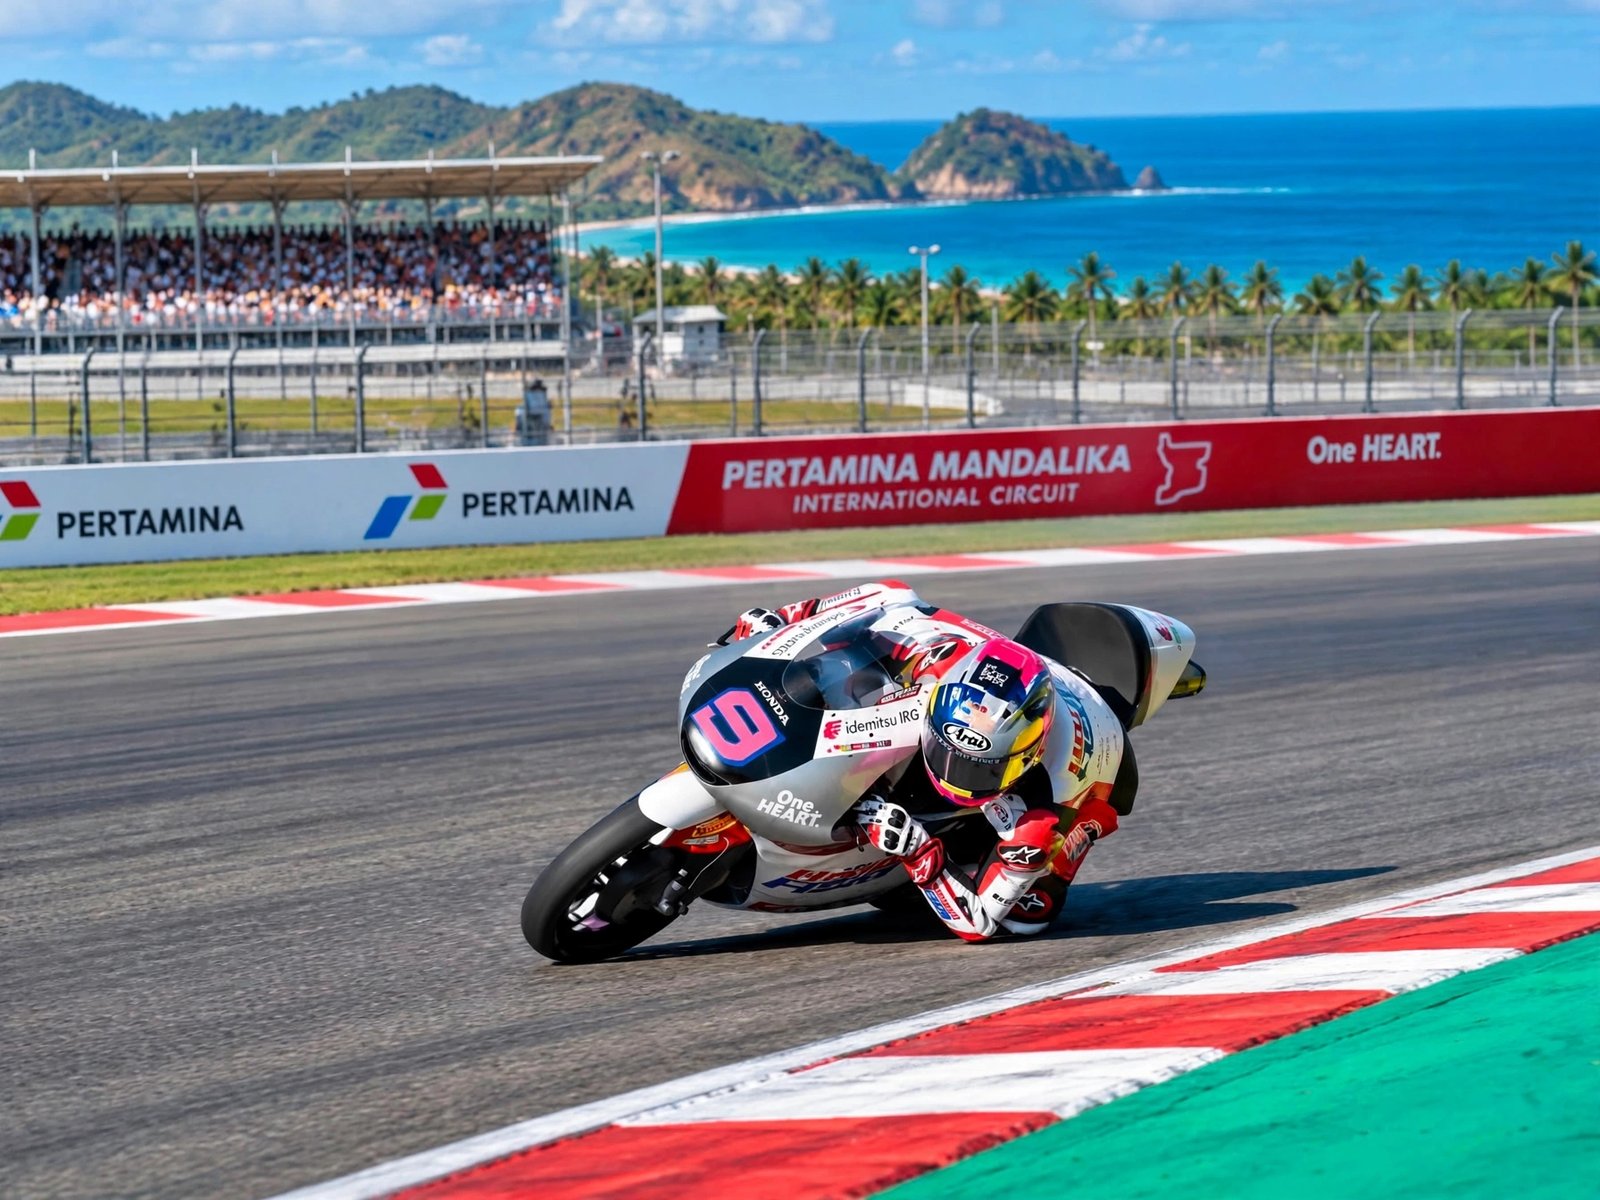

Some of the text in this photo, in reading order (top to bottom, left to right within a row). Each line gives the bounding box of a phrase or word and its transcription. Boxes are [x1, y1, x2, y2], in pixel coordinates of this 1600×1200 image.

[1307, 432, 1442, 464] One HEART.
[722, 444, 1131, 490] PERTAMINA MANDALIKA
[462, 486, 635, 518] PERTAMINA
[793, 482, 1080, 513] INTERNATIONAL CIRCUIT
[57, 505, 244, 539] PERTAMINA
[754, 681, 789, 726] HONDA
[690, 688, 784, 766] 9
[845, 709, 920, 734] idemitsu IRG
[949, 726, 986, 749] Arai
[757, 798, 822, 828] HEART.
